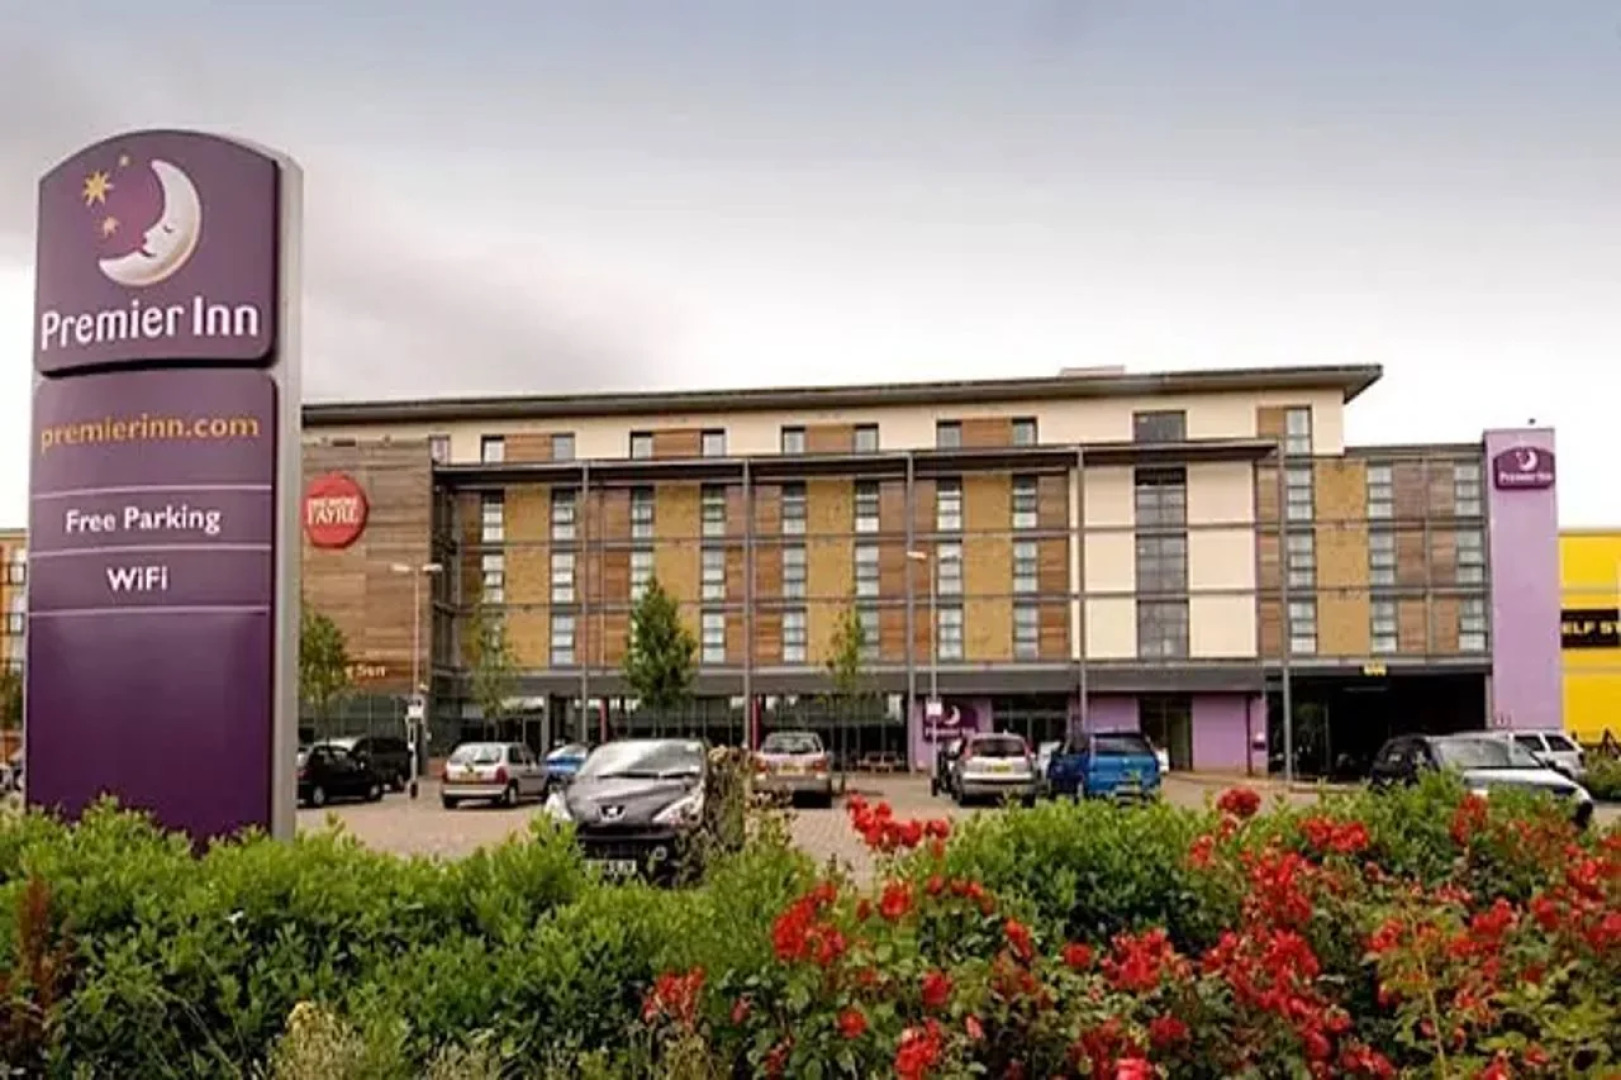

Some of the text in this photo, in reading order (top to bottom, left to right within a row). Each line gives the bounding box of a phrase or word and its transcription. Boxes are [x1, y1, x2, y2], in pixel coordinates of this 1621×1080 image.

[41, 296, 258, 350] Premier Inn
[41, 413, 259, 453] premierinn.com
[66, 504, 220, 535] Free Parking
[107, 566, 168, 591] WiFi
